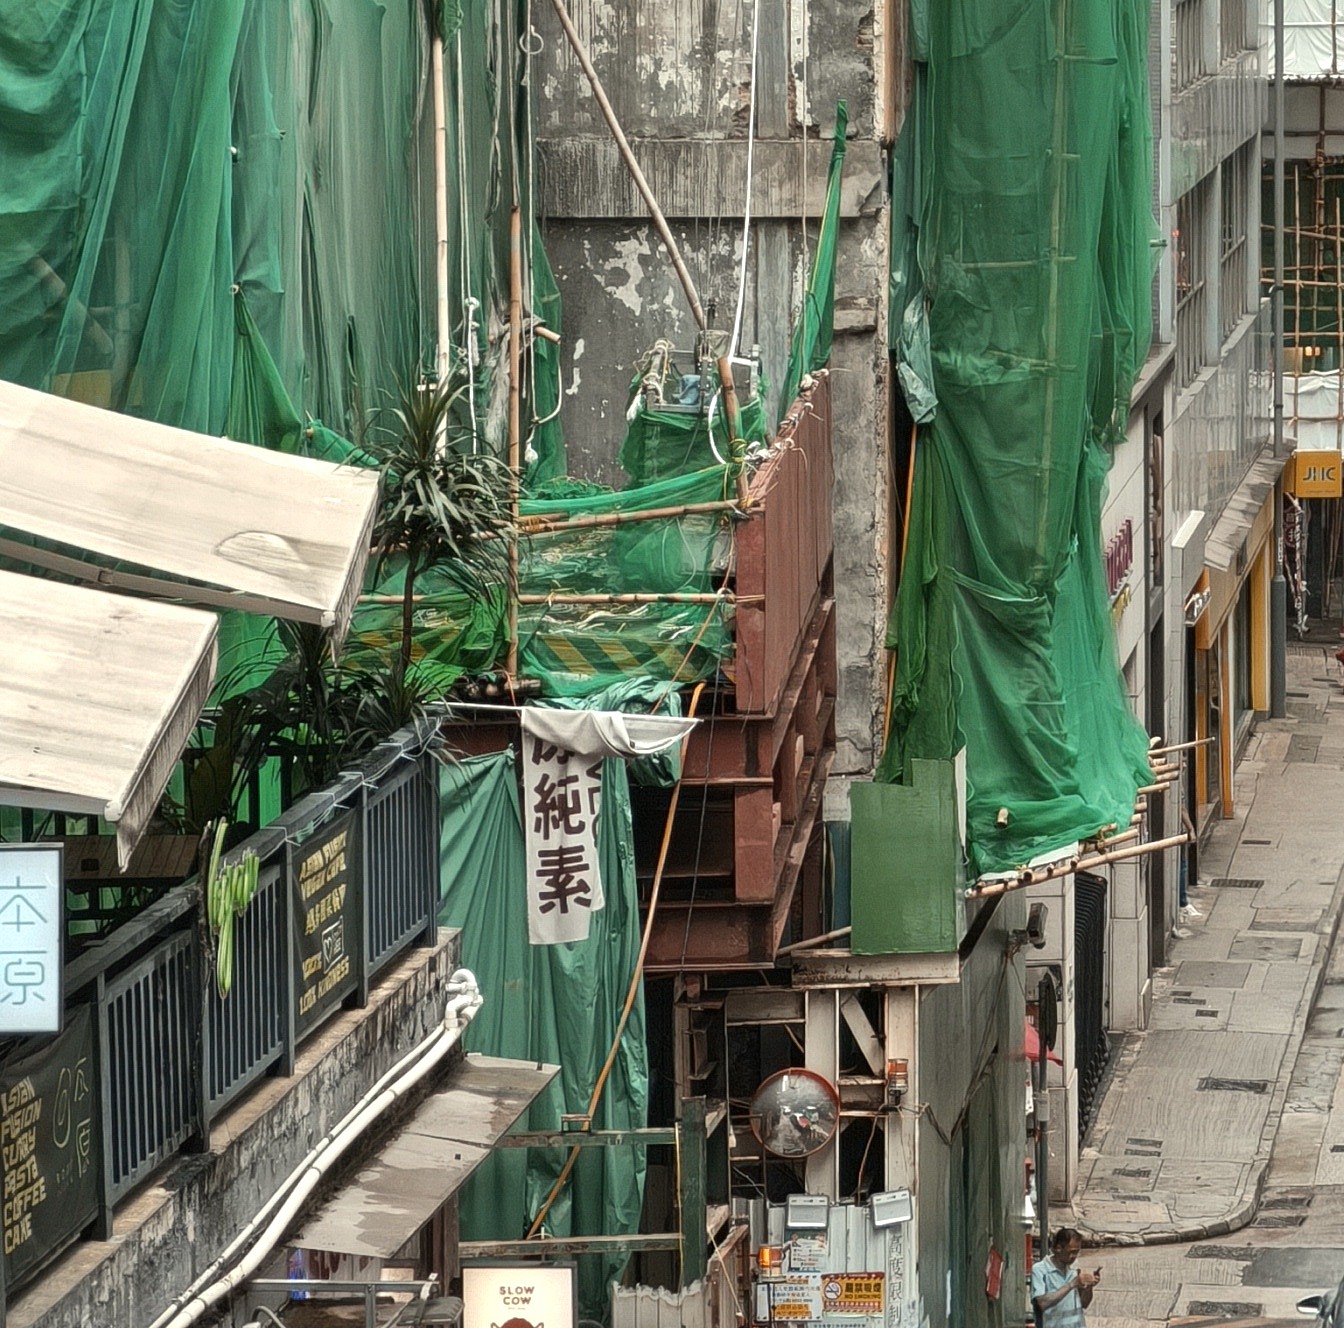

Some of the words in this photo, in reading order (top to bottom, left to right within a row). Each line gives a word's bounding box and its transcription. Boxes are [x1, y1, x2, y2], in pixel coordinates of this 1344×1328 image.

[1303, 467, 1336, 481] JHC
[2, 1098, 42, 1145] FUSION
[4, 1176, 47, 1228] COFFEE
[5, 1212, 32, 1256] CAKE
[499, 1286, 535, 1295] SLOW
[503, 1296, 531, 1305] COW
